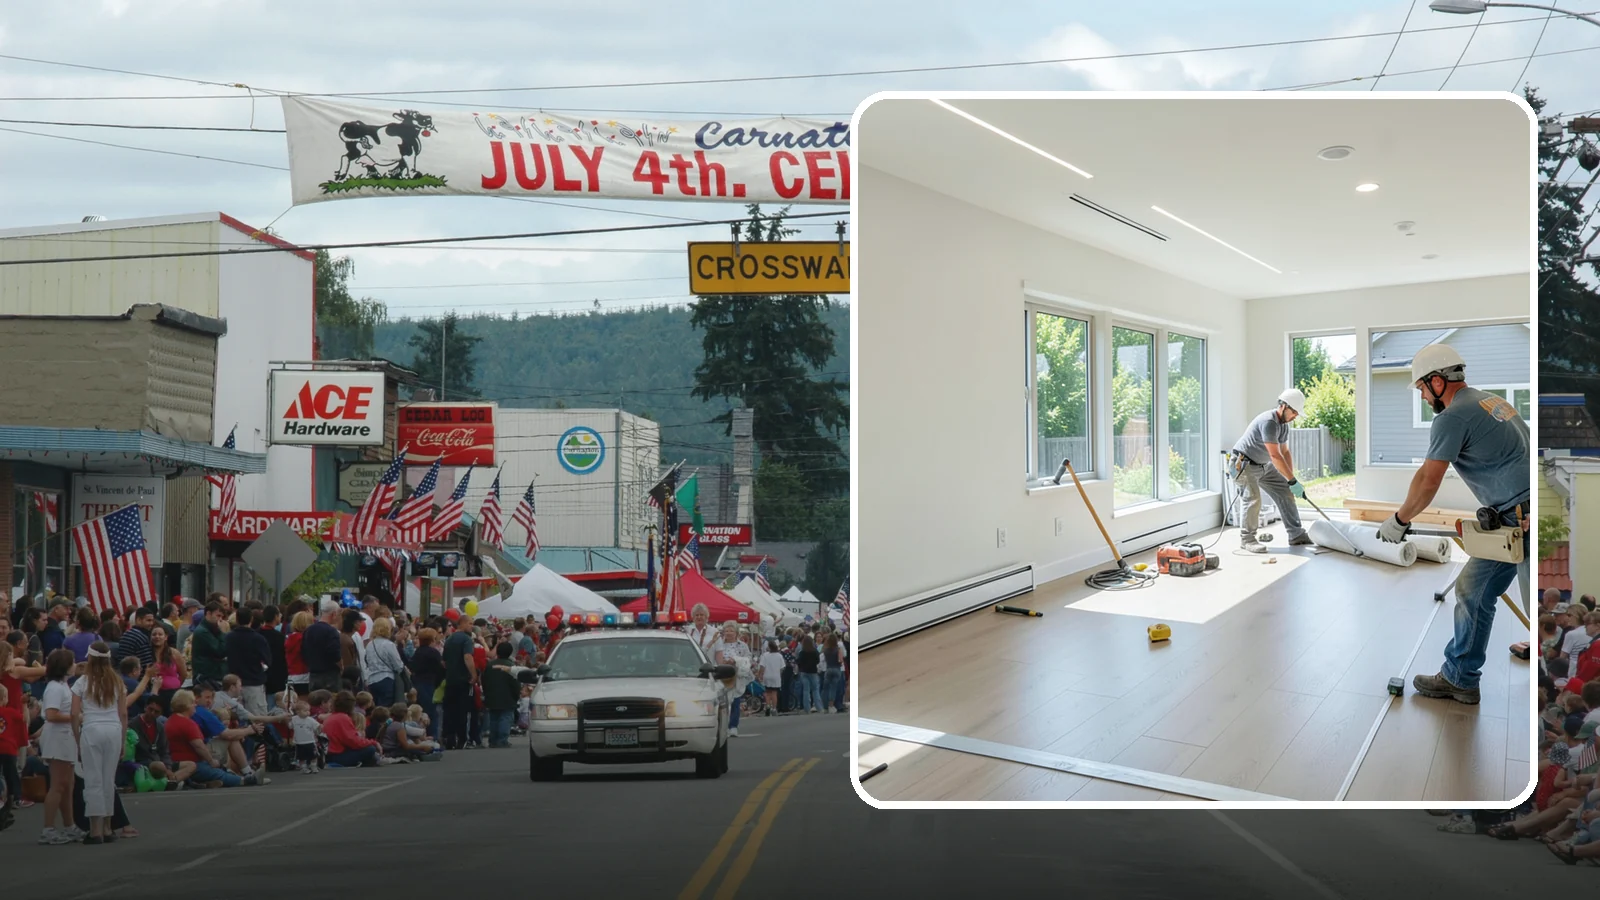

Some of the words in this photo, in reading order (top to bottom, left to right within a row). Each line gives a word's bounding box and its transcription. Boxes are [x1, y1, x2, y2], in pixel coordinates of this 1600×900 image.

[694, 121, 850, 150] Carnat
[481, 140, 605, 193] JULY
[632, 149, 747, 198] 4th.
[697, 254, 850, 280] CROSSWA
[283, 380, 373, 420] ACE
[406, 409, 452, 422] CEDAR
[461, 409, 485, 422] LOG
[283, 421, 371, 436] Hardware
[353, 467, 385, 478] Simpl
[95, 485, 124, 494] Vincent
[126, 485, 136, 495] de
[137, 486, 155, 495] Paul
[213, 516, 330, 535] HARDARE
[688, 526, 741, 535] CRNATION
[699, 535, 730, 543] GLASS
